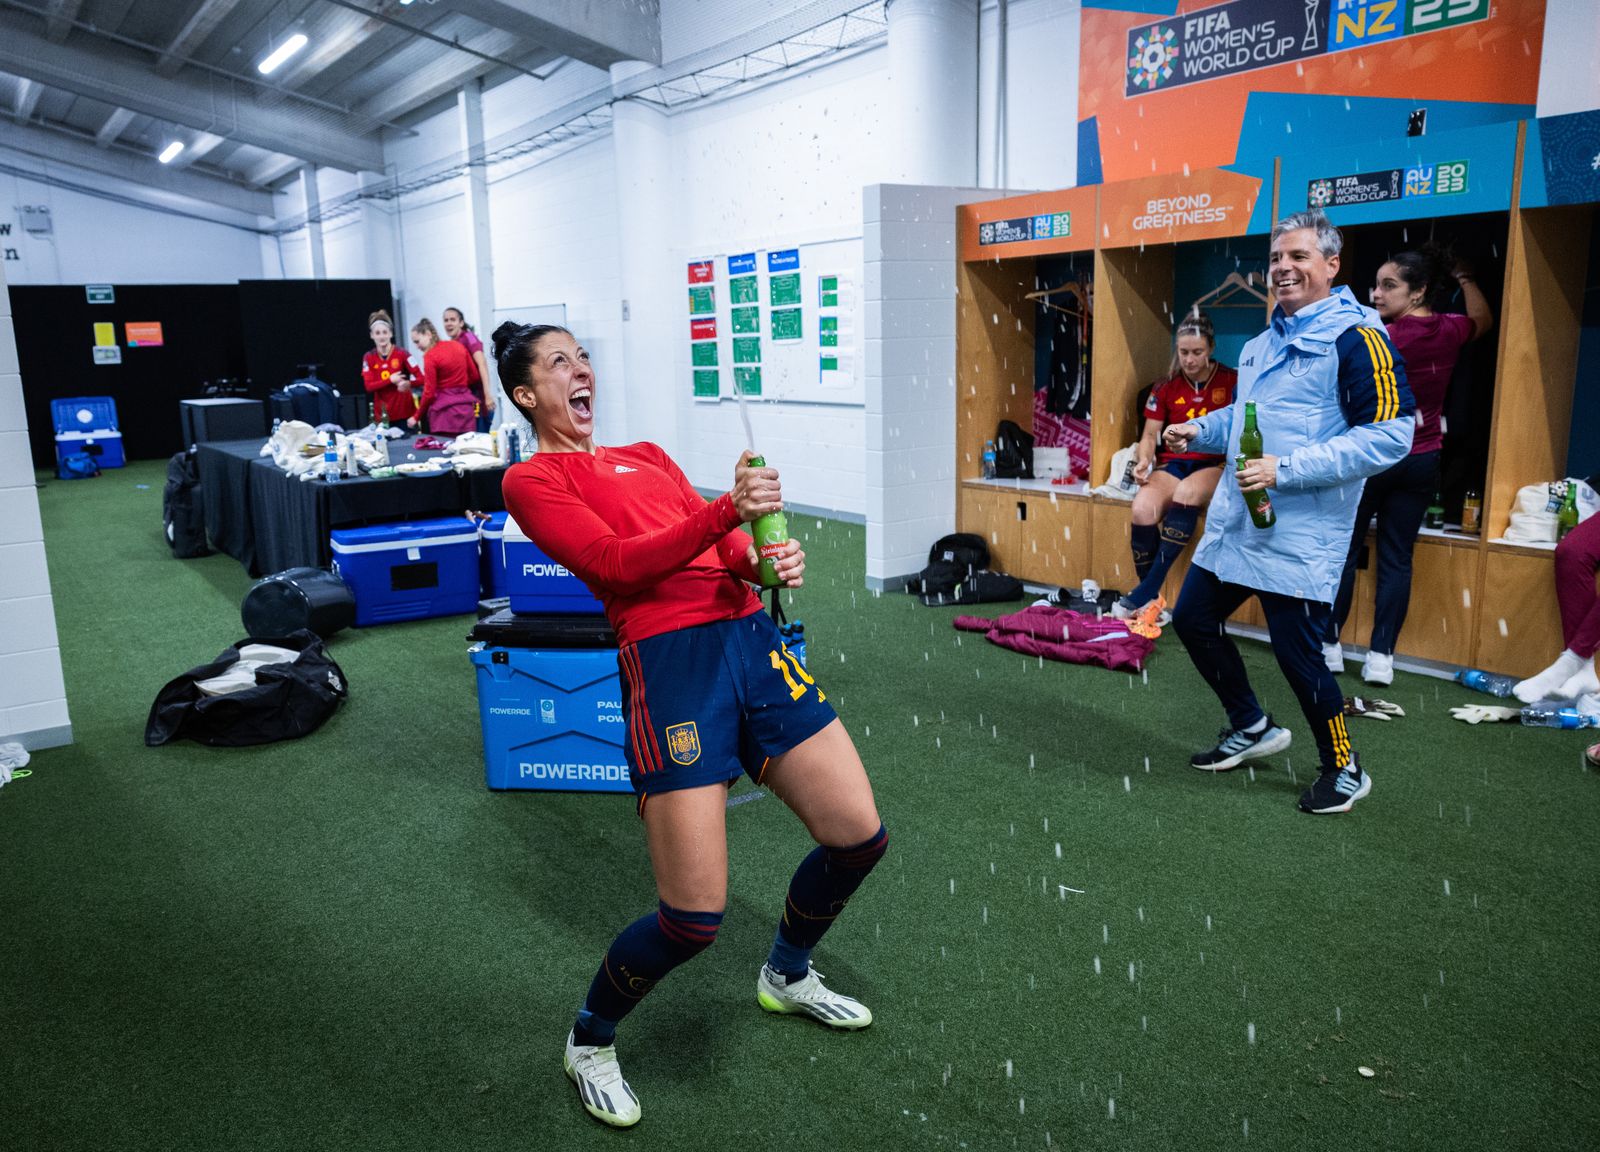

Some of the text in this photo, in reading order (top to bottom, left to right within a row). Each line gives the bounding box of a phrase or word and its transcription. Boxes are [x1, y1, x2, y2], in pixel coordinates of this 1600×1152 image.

[1184, 11, 1231, 40] FIFA
[1335, 1, 1397, 43] NZ
[1184, 20, 1276, 58] WOMEN'S
[1183, 36, 1295, 78] WORLD CUP
[1406, 167, 1433, 183] AU
[1437, 163, 1466, 179] 20
[1335, 182, 1380, 195] WOMEN'S
[1336, 176, 1359, 187] FIFA
[1405, 181, 1431, 196] NZ
[1436, 178, 1464, 193] 23
[1146, 193, 1211, 214] BEYOND
[1335, 191, 1389, 204] WORLD CUP
[1035, 215, 1051, 227] AU
[1053, 214, 1069, 225] 20
[1132, 206, 1227, 230] GREATNESS
[1053, 225, 1069, 236] 23
[489, 707, 531, 716] POWERADE
[520, 763, 630, 781] POWERADE
